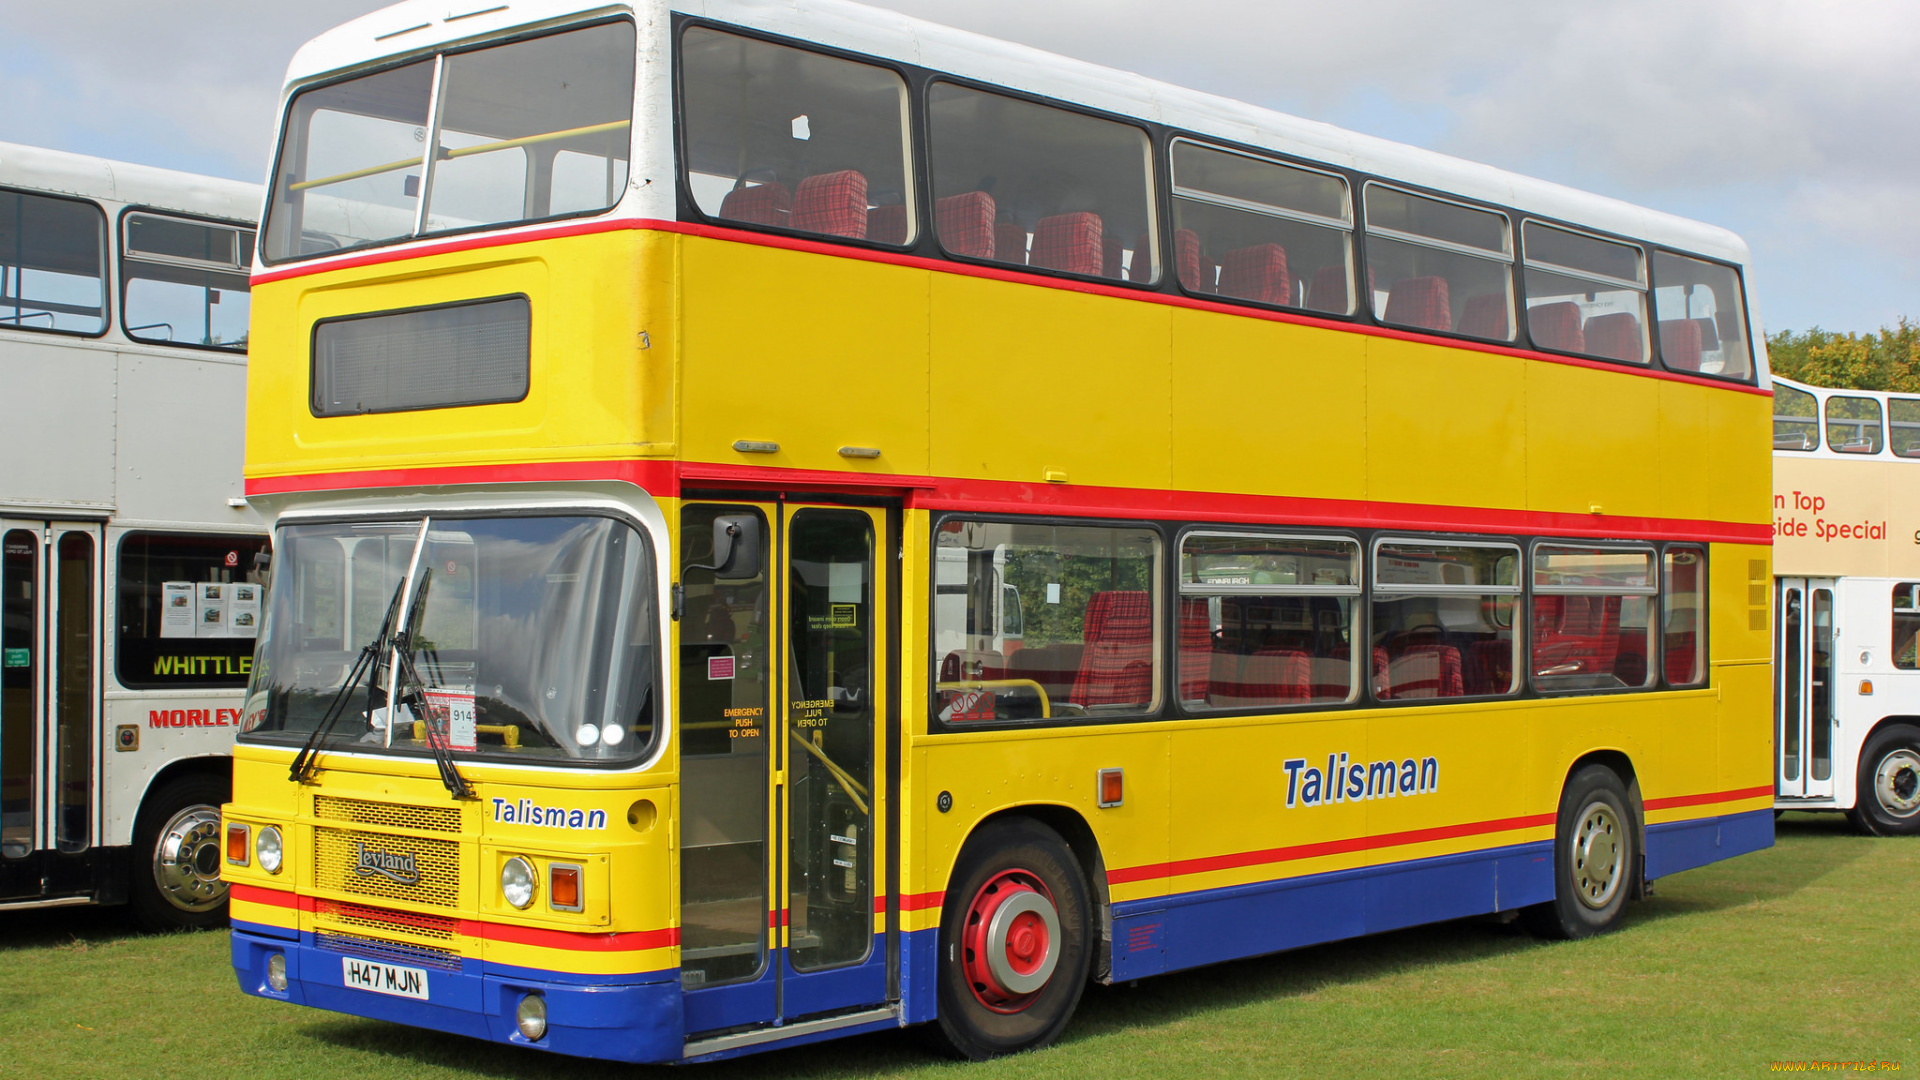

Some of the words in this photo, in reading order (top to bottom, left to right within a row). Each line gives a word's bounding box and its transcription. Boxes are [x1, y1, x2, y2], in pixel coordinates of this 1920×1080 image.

[1792, 491, 1825, 515] Top
[1815, 518, 1886, 543] Special
[453, 709, 473, 722] 914
[723, 707, 764, 717] EMERGENCY
[735, 718, 753, 727] PUSH
[728, 729, 739, 738] TO
[740, 728, 760, 738] OPEN
[1282, 752, 1439, 808] Talisman
[491, 797, 608, 830] Talisman
[355, 842, 419, 883] Leyland
[350, 961, 381, 988] H47
[385, 967, 420, 994] MJN
